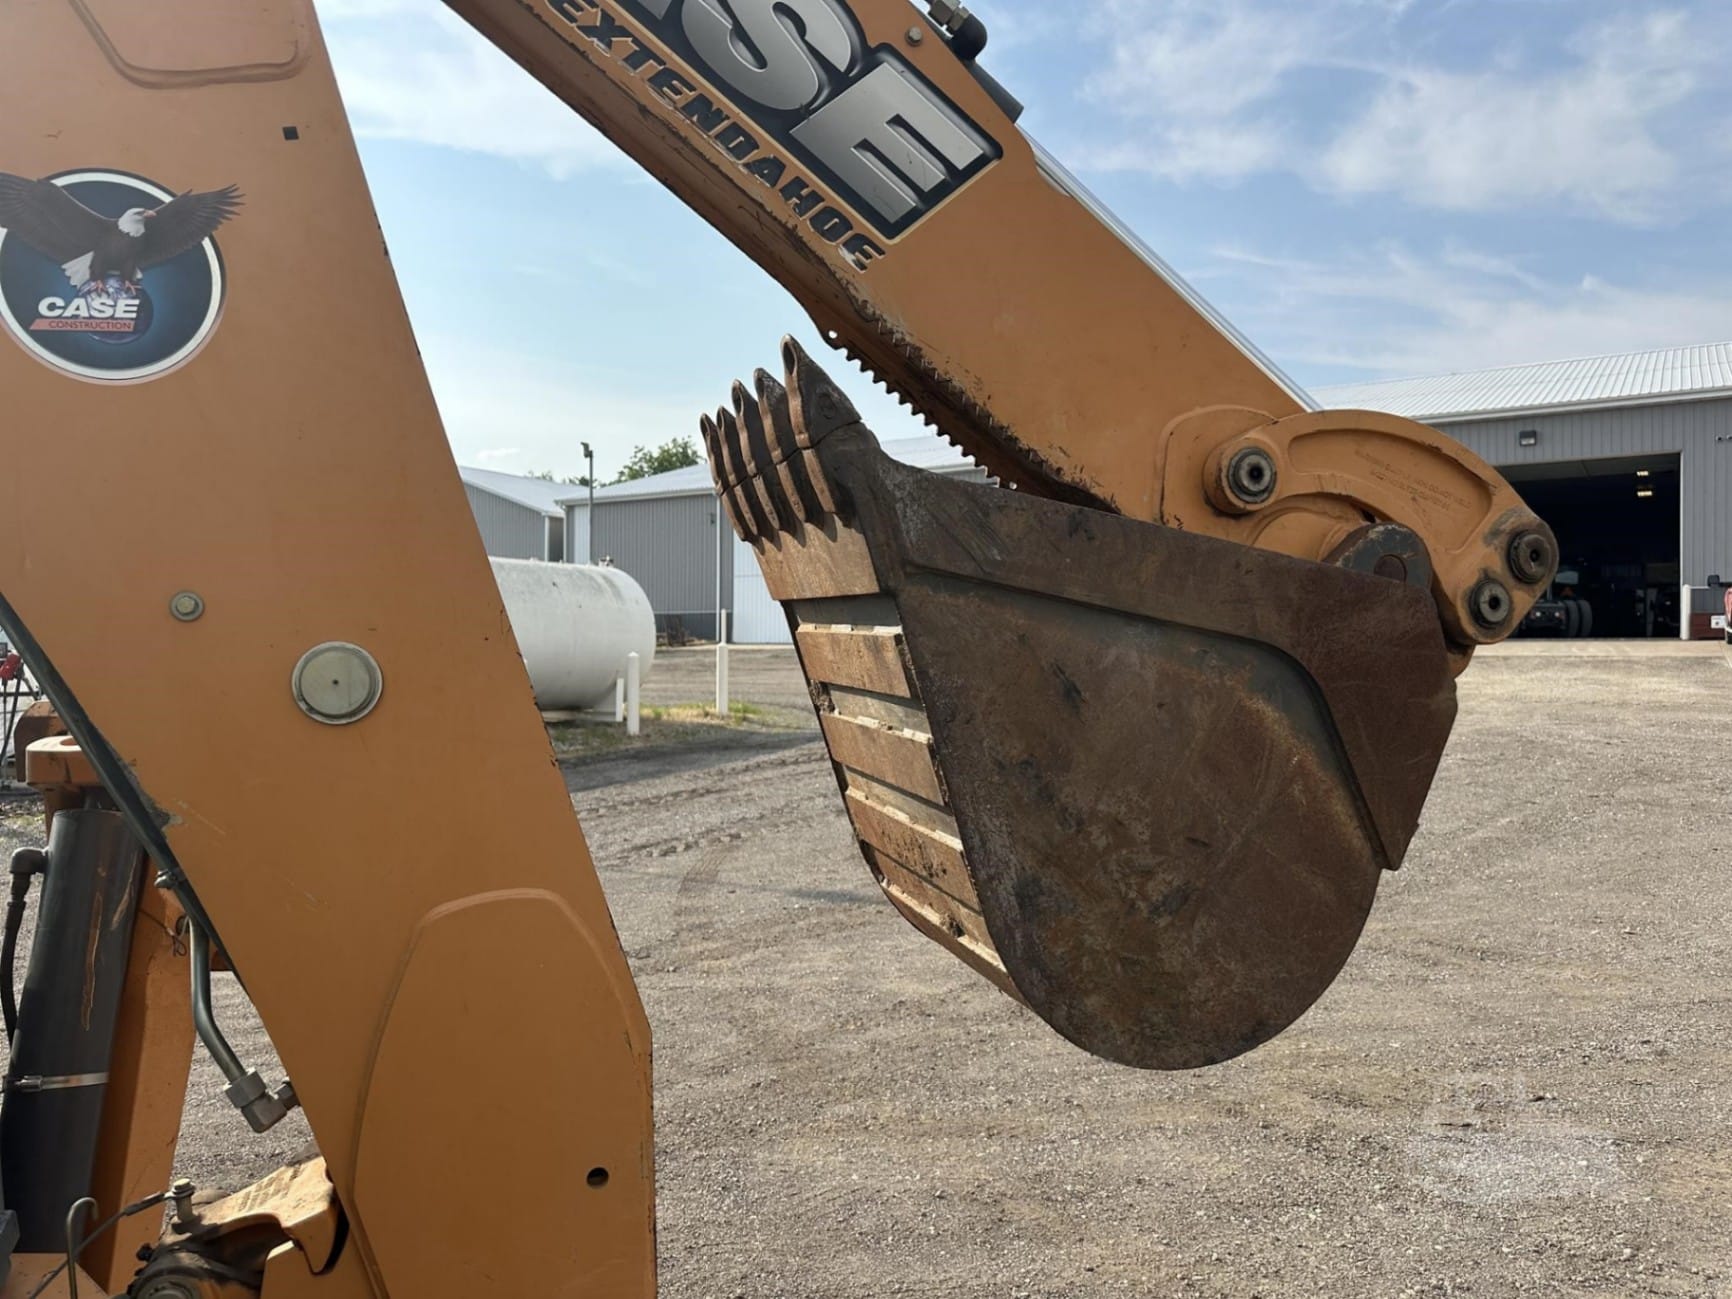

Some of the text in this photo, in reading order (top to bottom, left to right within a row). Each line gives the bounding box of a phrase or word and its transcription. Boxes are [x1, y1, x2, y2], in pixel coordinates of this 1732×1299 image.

[545, 0, 886, 272] EXTENDAHOE
[627, 0, 983, 224] SE
[38, 296, 140, 318] CASE
[48, 320, 132, 330] CONSTRUCTION
